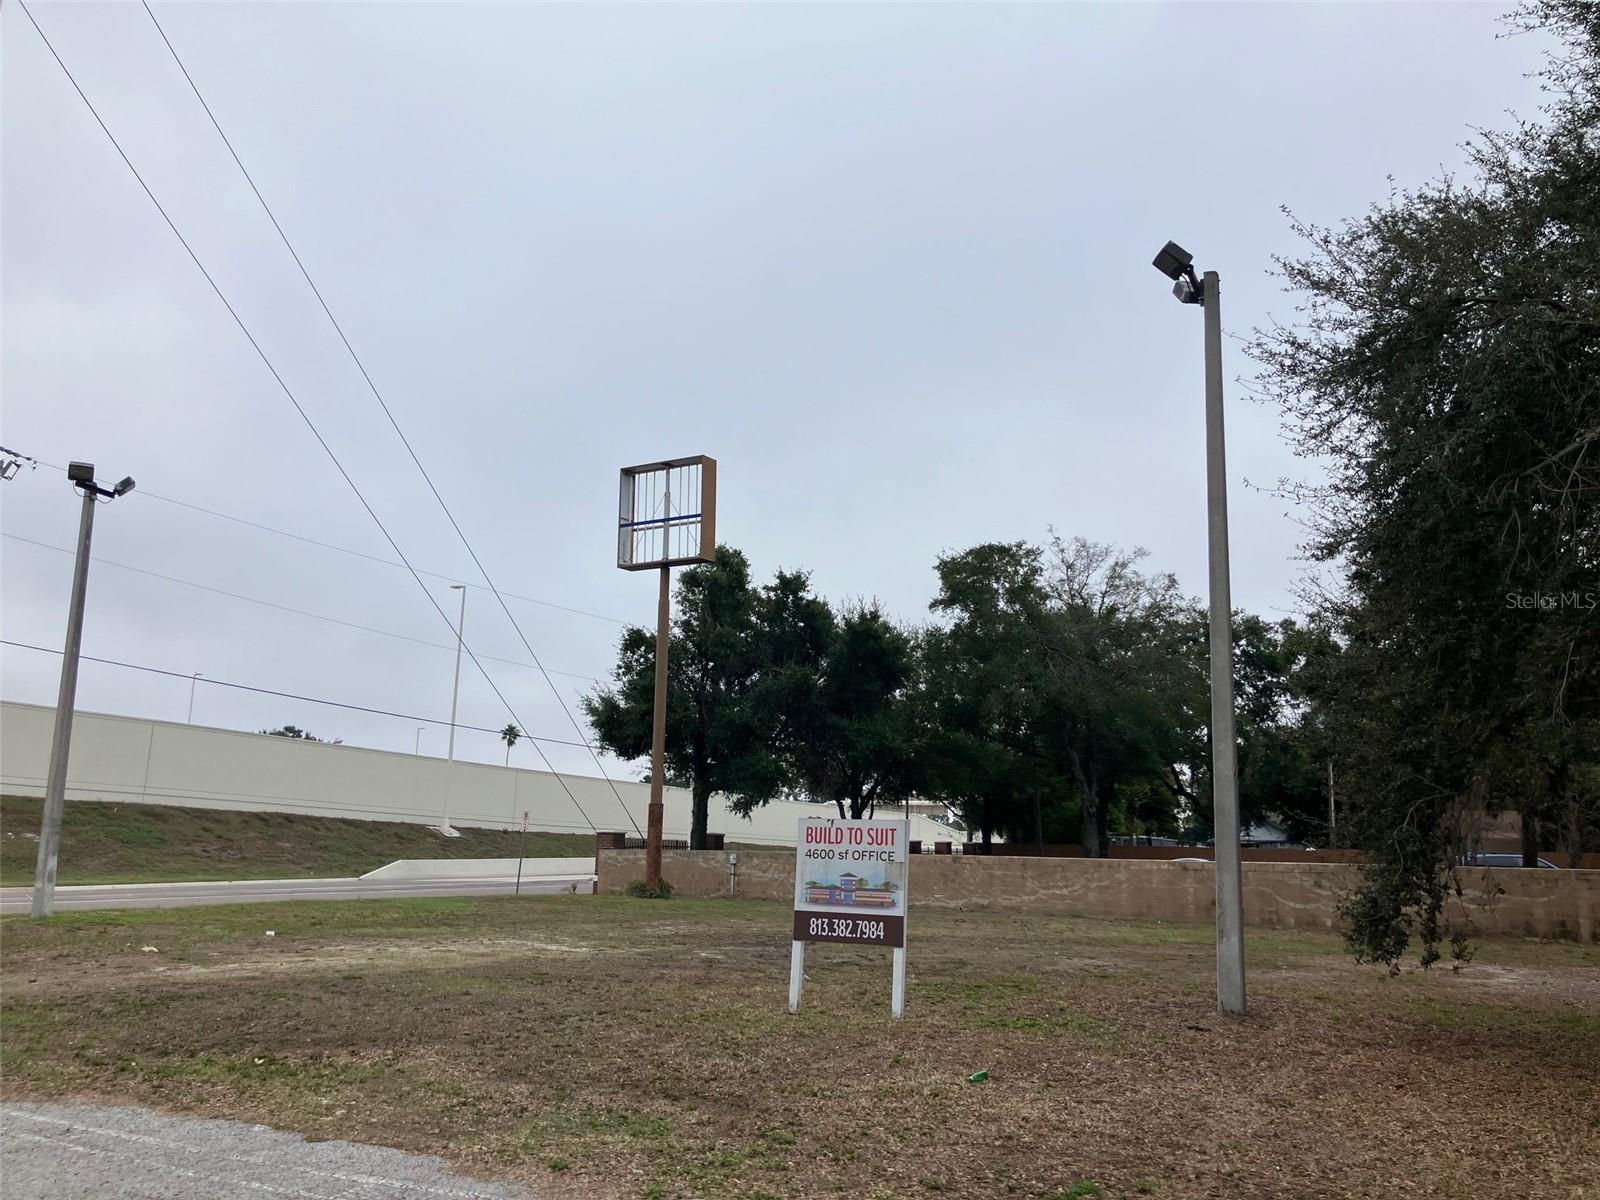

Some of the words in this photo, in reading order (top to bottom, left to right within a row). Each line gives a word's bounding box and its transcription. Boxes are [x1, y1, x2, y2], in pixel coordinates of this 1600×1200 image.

[806, 827, 843, 844] BUILD
[847, 828, 863, 845] TO
[867, 828, 897, 846] SUIT
[805, 849, 835, 859] 4600
[838, 850, 849, 860] sf
[852, 850, 895, 862] OFFICE
[809, 918, 884, 939] 813.382.7984
